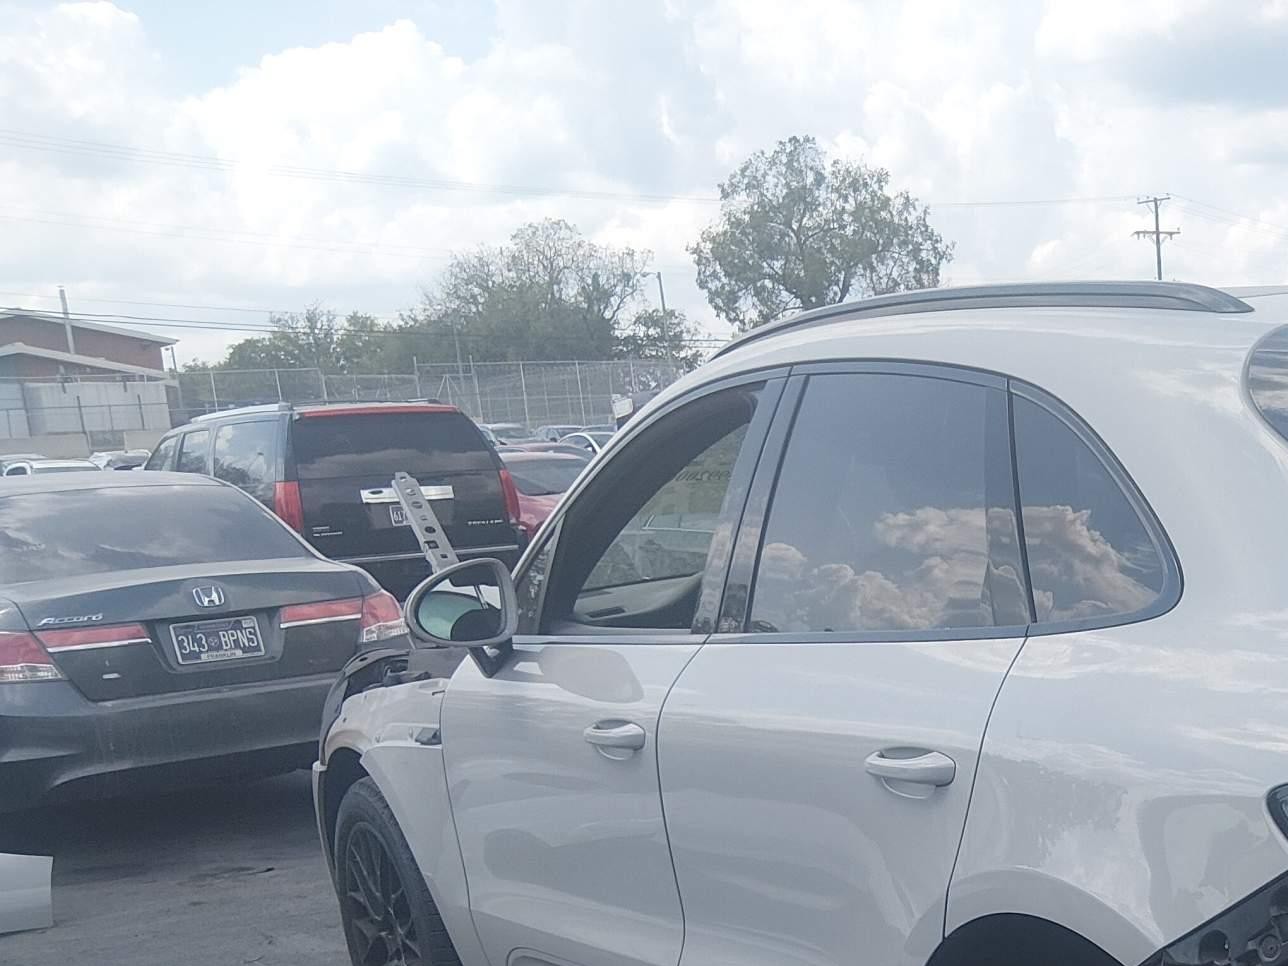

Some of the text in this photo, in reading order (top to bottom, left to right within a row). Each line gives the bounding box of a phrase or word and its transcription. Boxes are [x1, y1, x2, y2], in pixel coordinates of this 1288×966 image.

[37, 612, 104, 627] Accord
[178, 628, 258, 654] 343 BPNS
